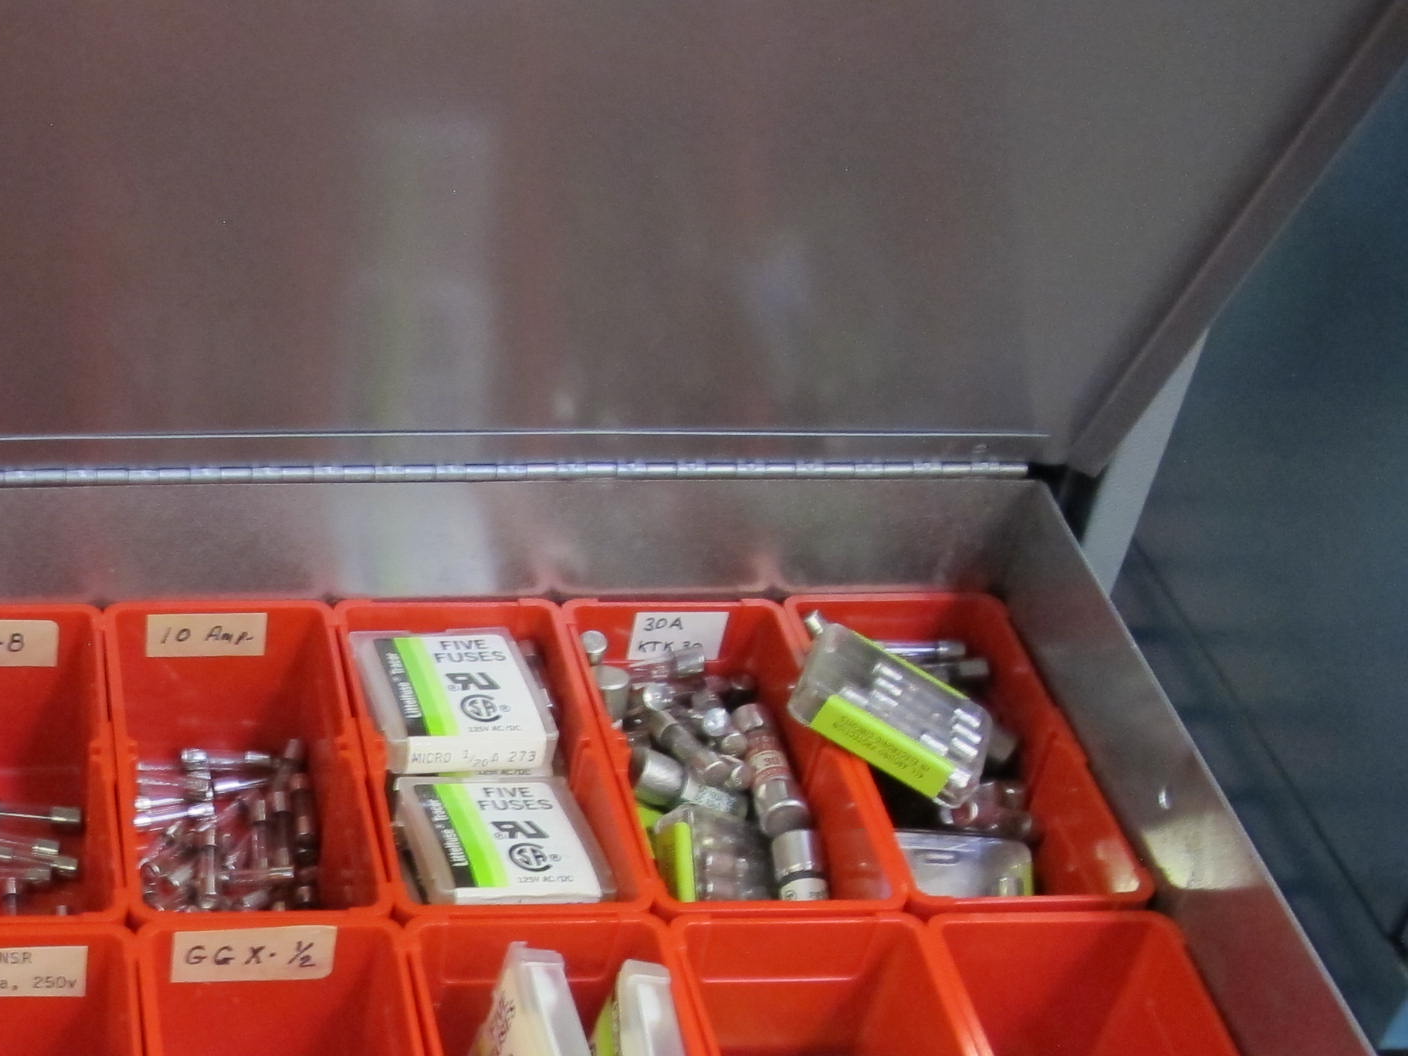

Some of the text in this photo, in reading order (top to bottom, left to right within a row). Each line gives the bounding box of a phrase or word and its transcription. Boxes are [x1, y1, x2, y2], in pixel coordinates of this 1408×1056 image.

[440, 639, 487, 650] FIVE
[434, 651, 506, 663] FUSES
[482, 787, 534, 798] FIVE
[478, 799, 554, 811] FUSES
